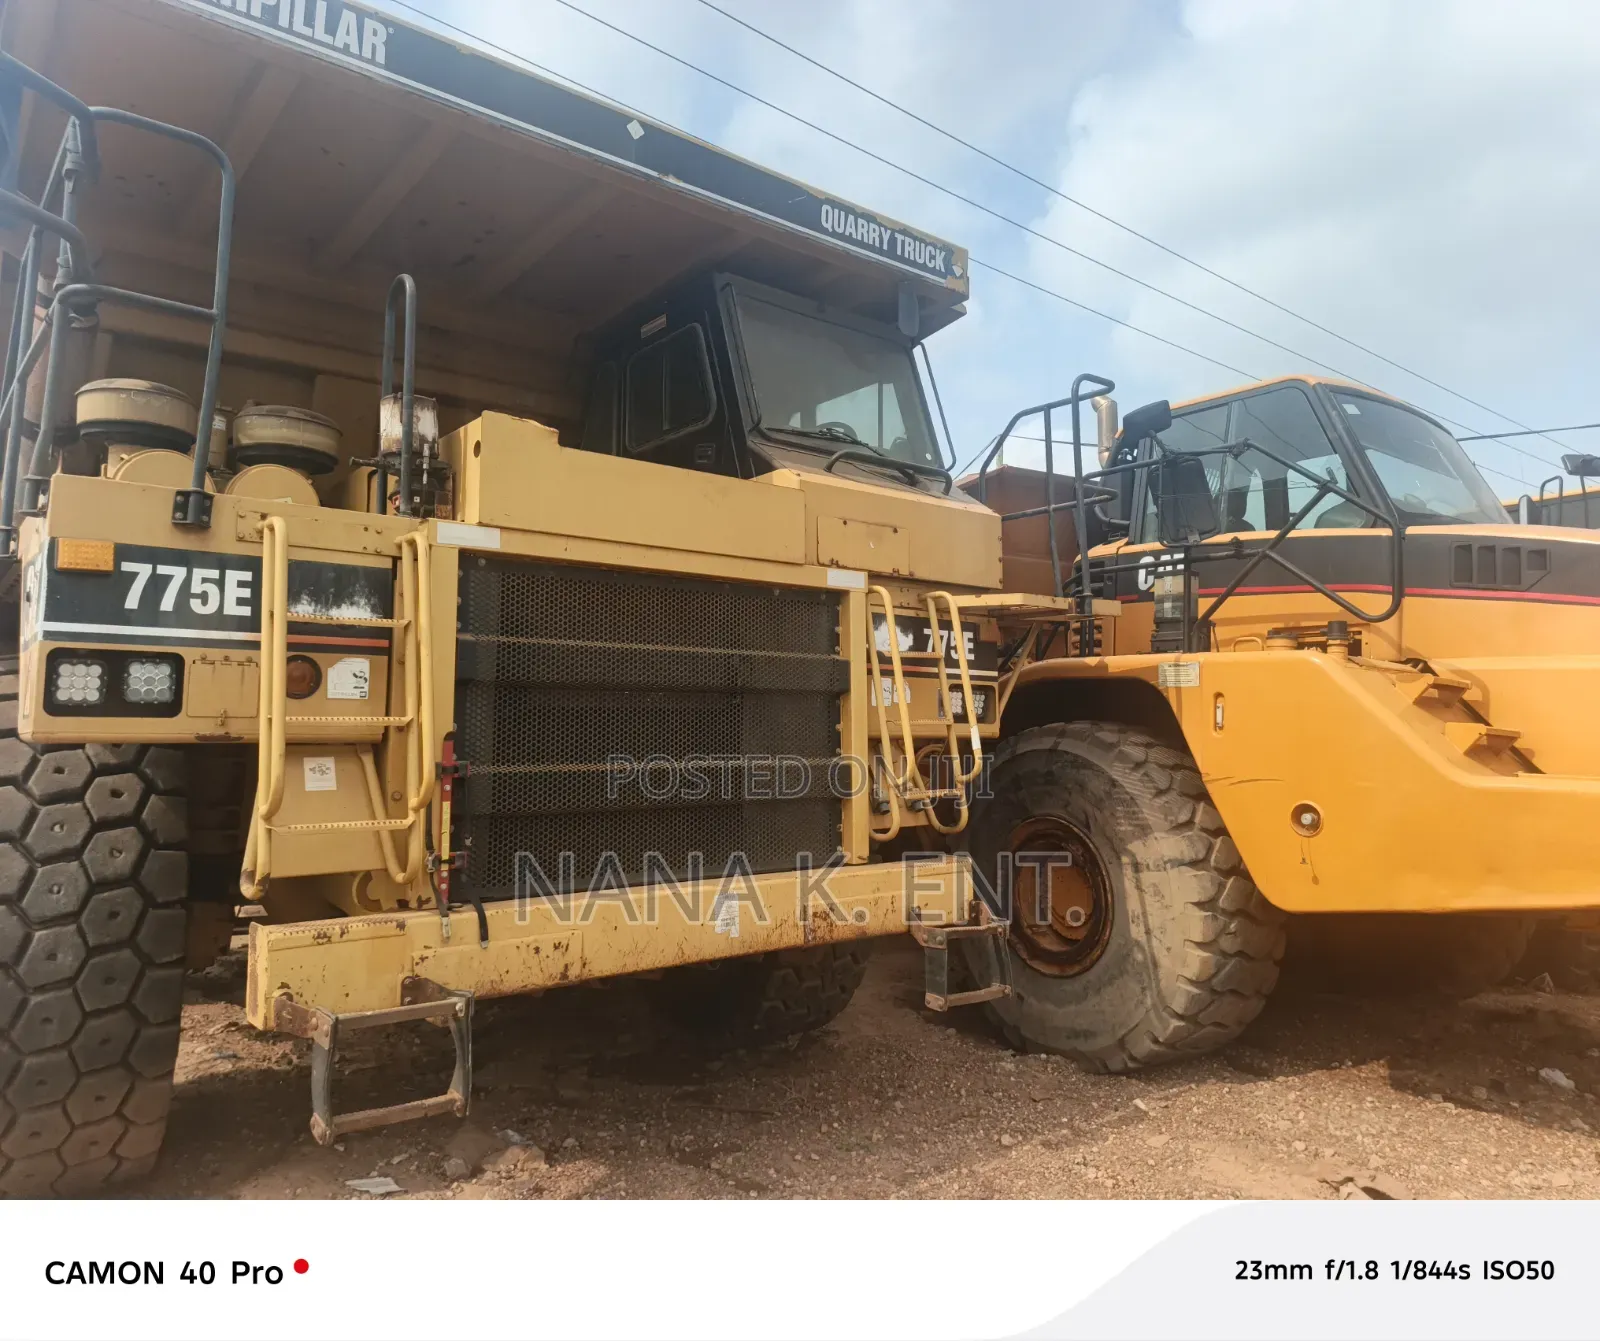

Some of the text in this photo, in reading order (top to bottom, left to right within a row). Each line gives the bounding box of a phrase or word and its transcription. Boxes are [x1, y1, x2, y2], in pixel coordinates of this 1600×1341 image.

[820, 204, 946, 273] QUARRY TRUCK
[120, 561, 253, 617] 775E
[923, 628, 975, 661] 775E
